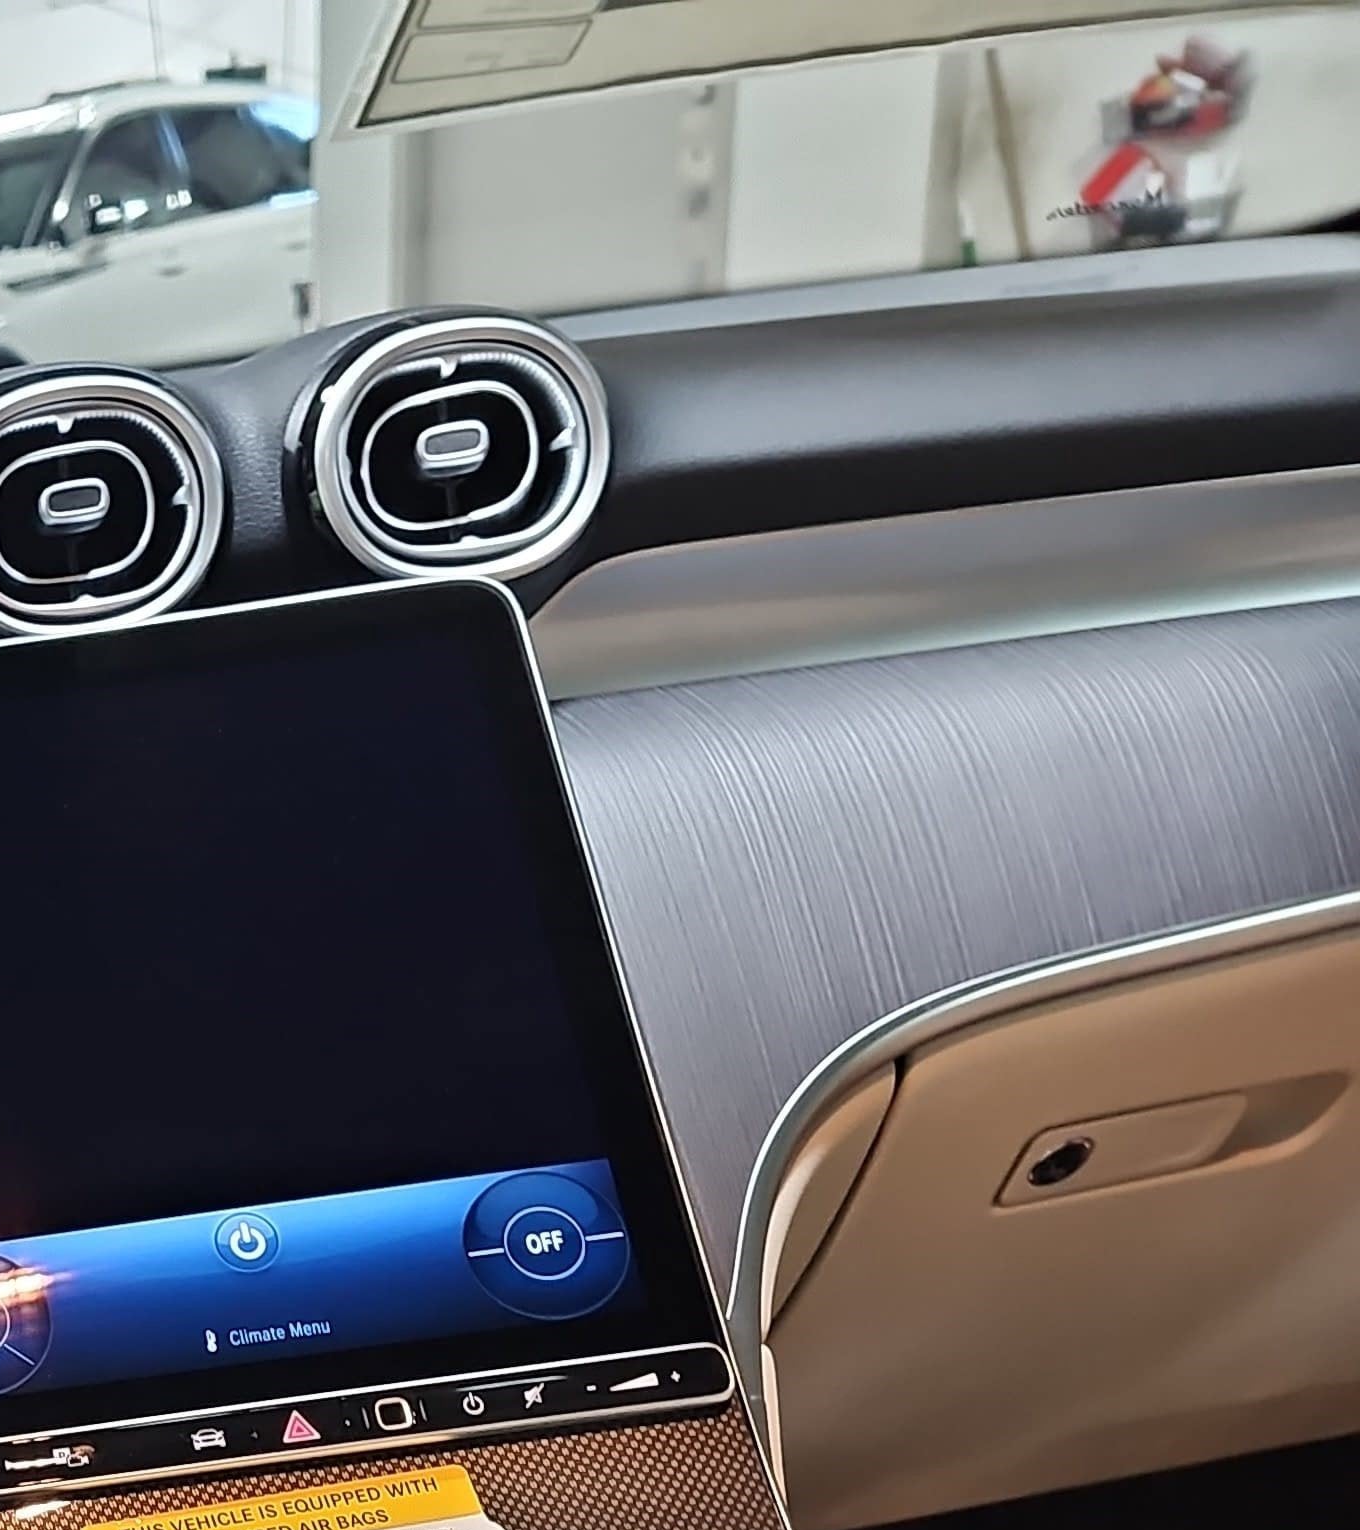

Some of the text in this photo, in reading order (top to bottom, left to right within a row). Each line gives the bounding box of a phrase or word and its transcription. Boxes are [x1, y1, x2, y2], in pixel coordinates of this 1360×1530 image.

[525, 1229, 564, 1255] OFF
[229, 1321, 331, 1347] Climate Menu
[258, 1504, 278, 1519] IS
[282, 1487, 381, 1515] EQUIPPED
[384, 1477, 438, 1498] WITH
[336, 1509, 389, 1530] BAGS
